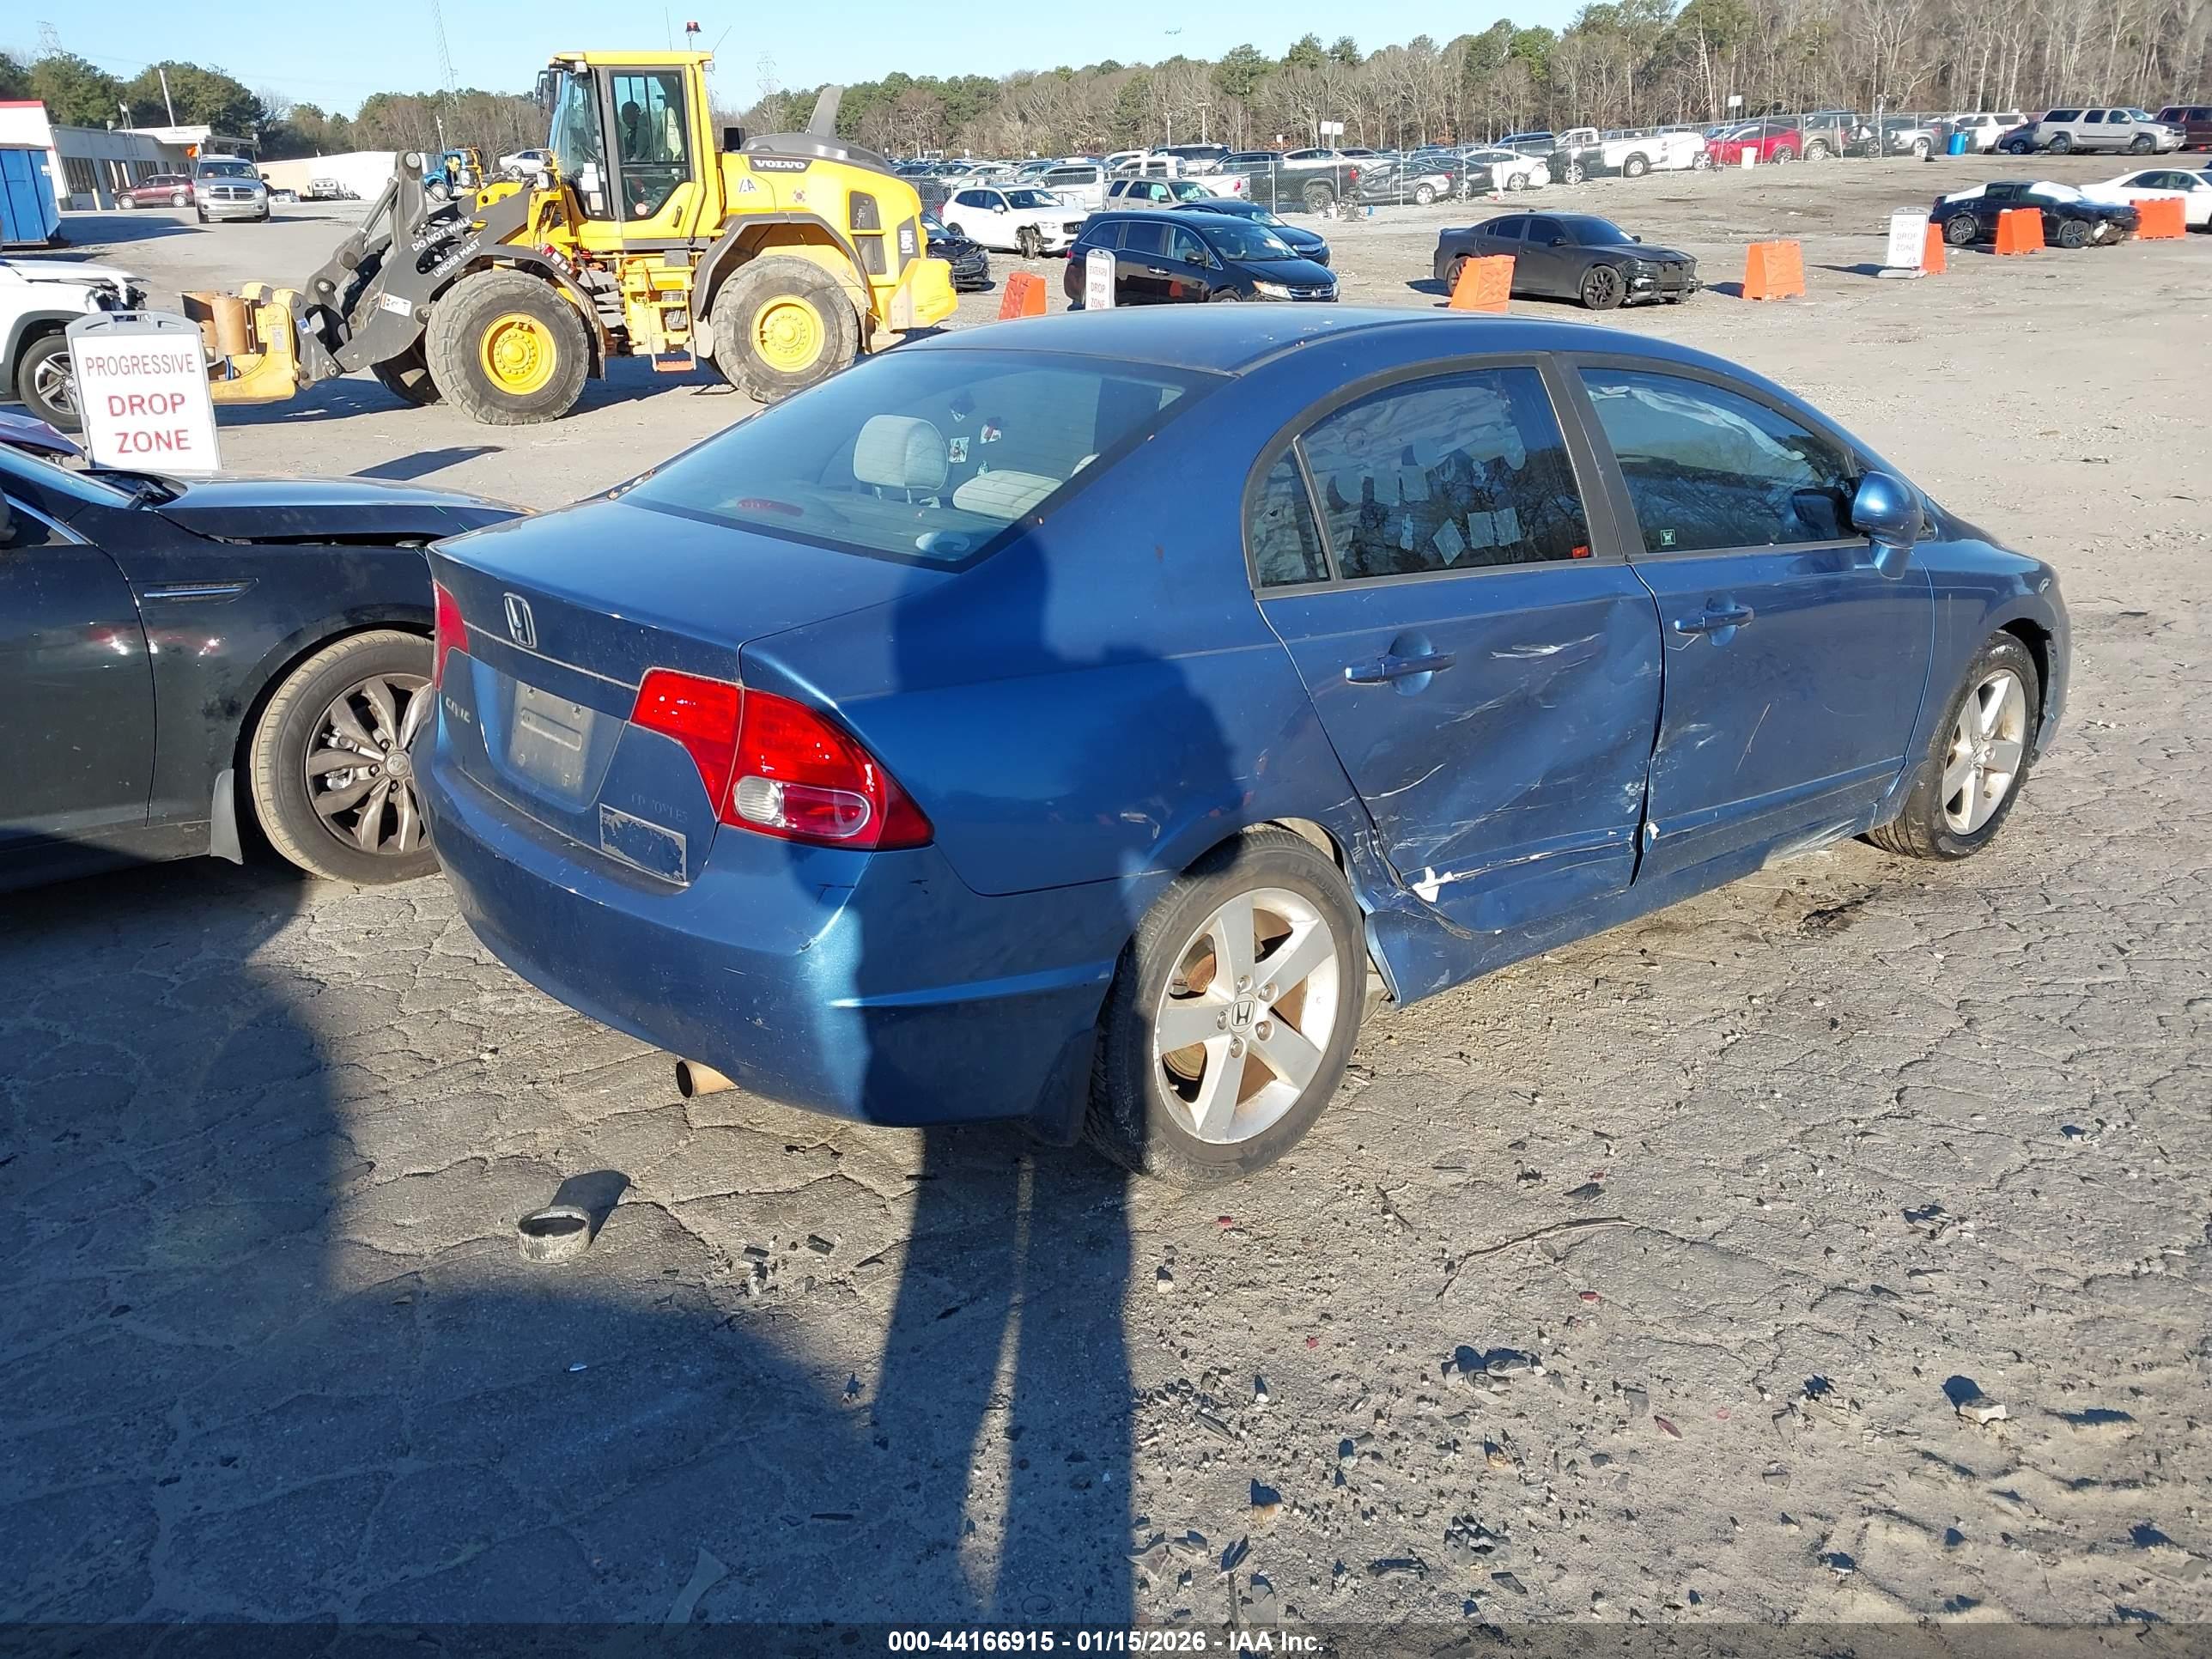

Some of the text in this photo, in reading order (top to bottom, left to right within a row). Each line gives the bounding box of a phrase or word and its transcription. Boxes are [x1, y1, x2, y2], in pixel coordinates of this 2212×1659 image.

[753, 159, 806, 169] VOLVO
[411, 216, 472, 252] DO NOT WALK
[433, 238, 481, 277] UNDER MAST
[1091, 281, 1106, 294] DROP
[85, 353, 196, 377] PROGRESSIVE
[107, 392, 186, 417] DROP
[115, 428, 192, 454] ZONE
